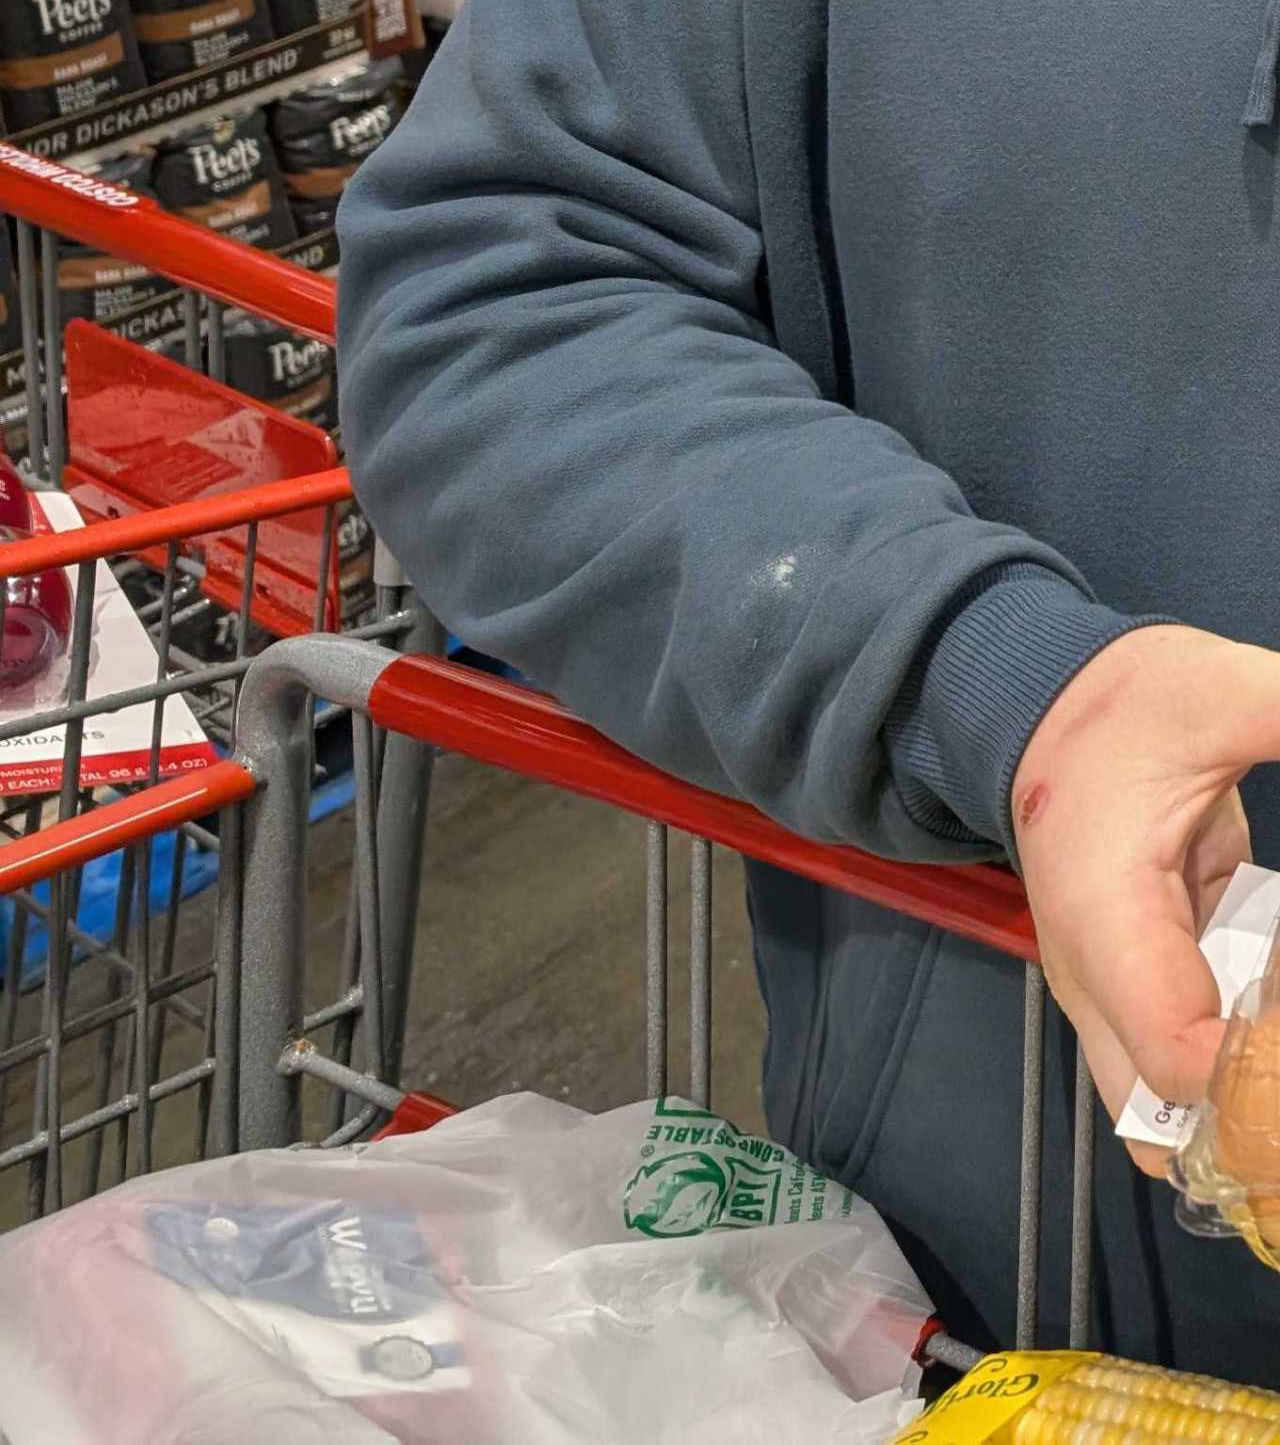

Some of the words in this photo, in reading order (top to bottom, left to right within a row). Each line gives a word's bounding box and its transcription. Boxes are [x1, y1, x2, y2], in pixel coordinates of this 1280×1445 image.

[75, 77, 219, 149] DICKASON'S
[224, 48, 299, 93] BLEND
[186, 136, 261, 185] Peet's
[109, 768, 131, 779] 96
[646, 1125, 785, 1163] COMPOSTABLE
